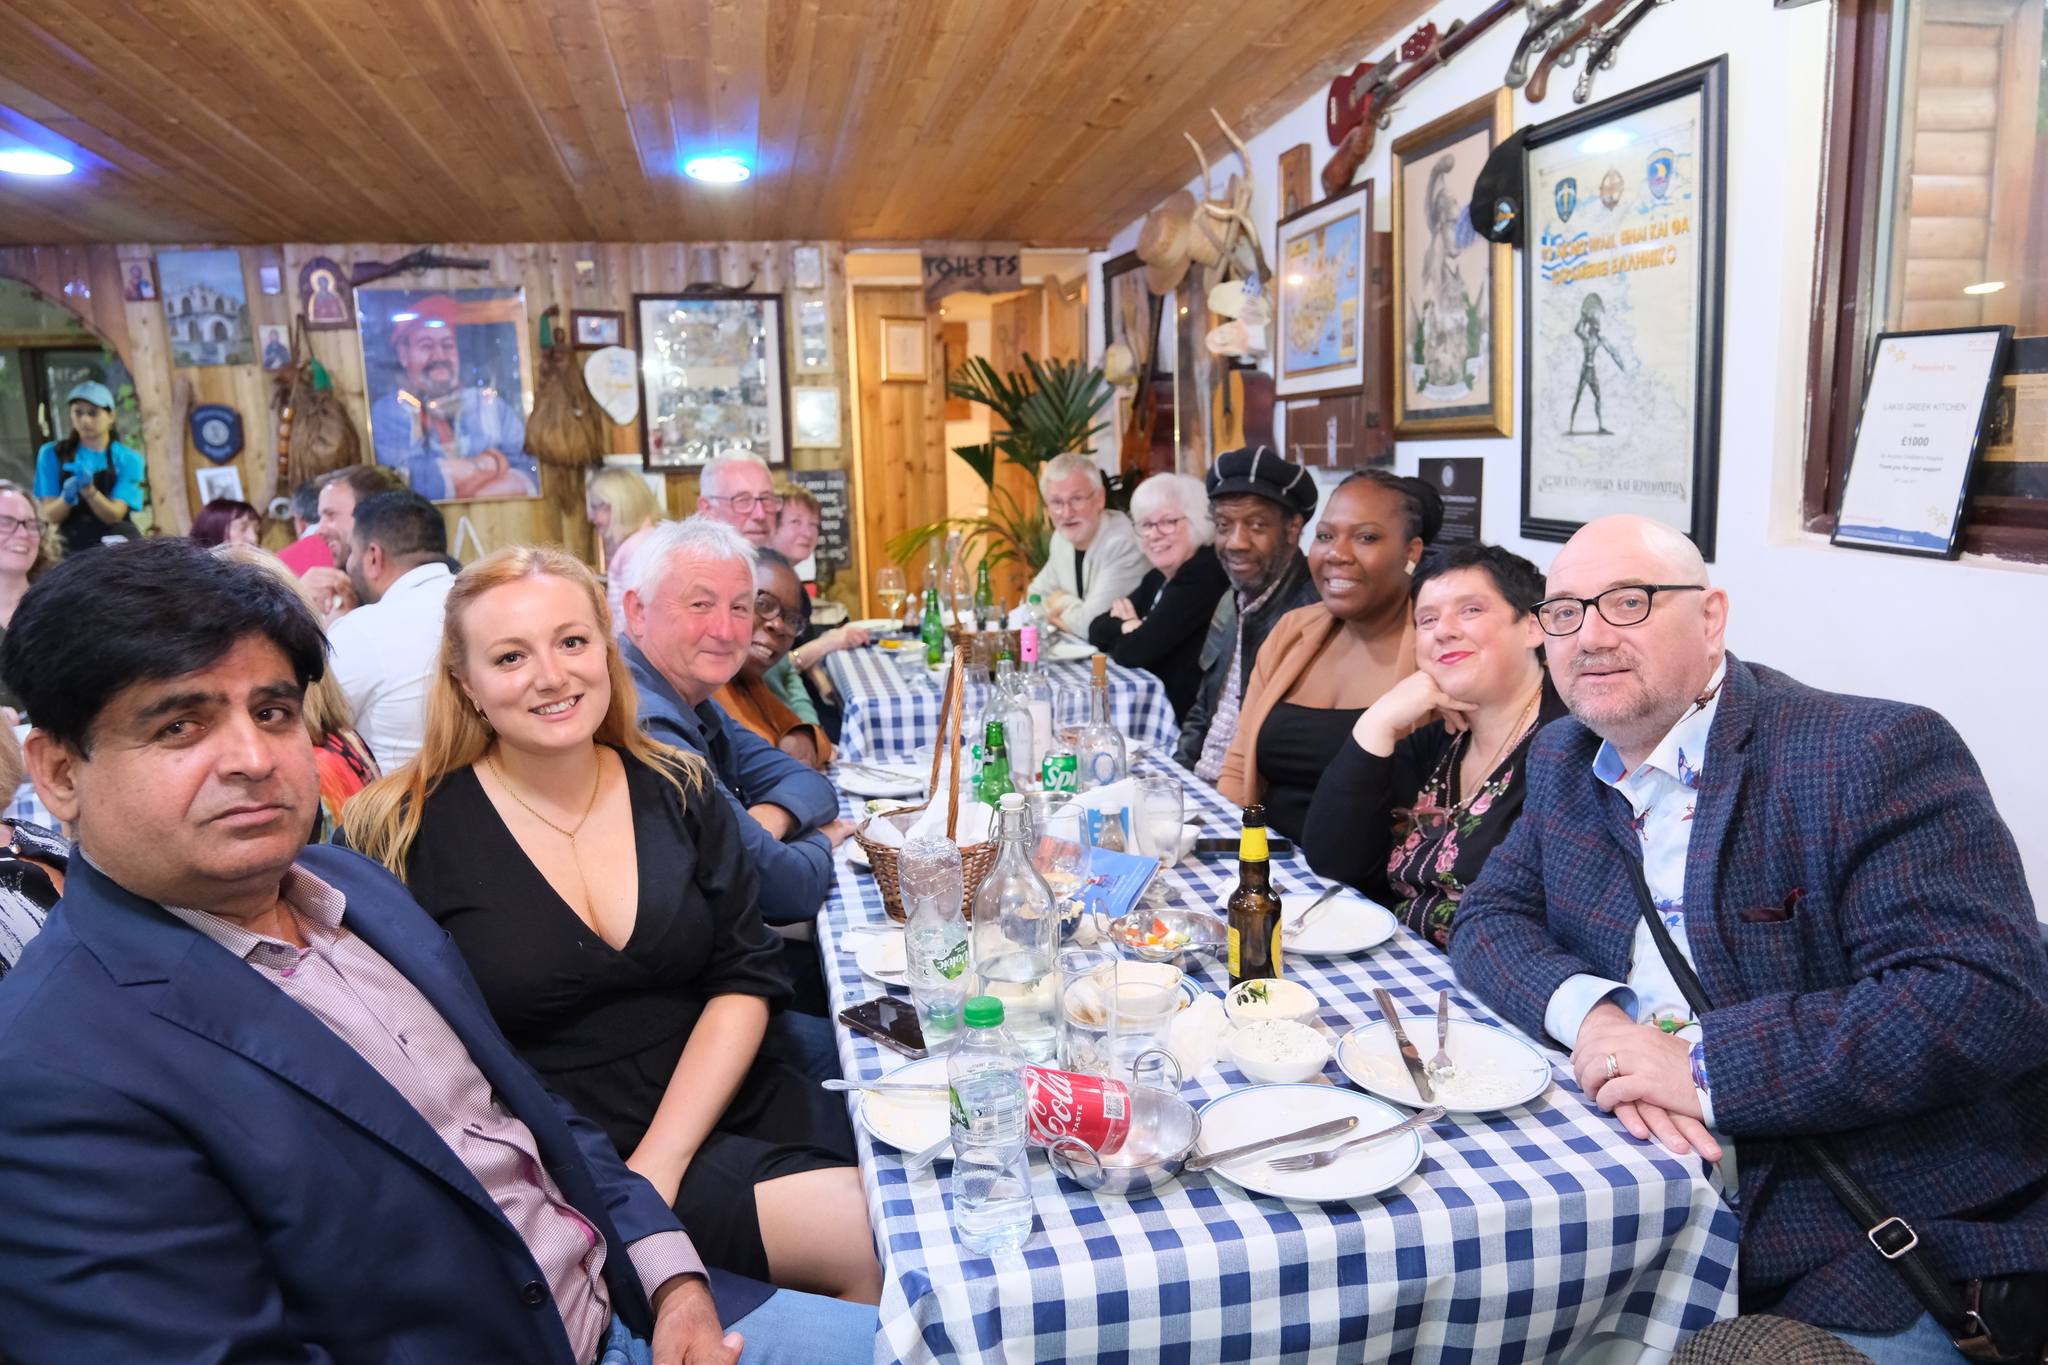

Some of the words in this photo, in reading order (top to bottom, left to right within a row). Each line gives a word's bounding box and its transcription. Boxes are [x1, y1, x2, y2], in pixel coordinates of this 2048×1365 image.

[923, 254, 1018, 277] TOILETS
[1901, 436, 1929, 447] £1000
[1071, 1103, 1084, 1133] TASTE
